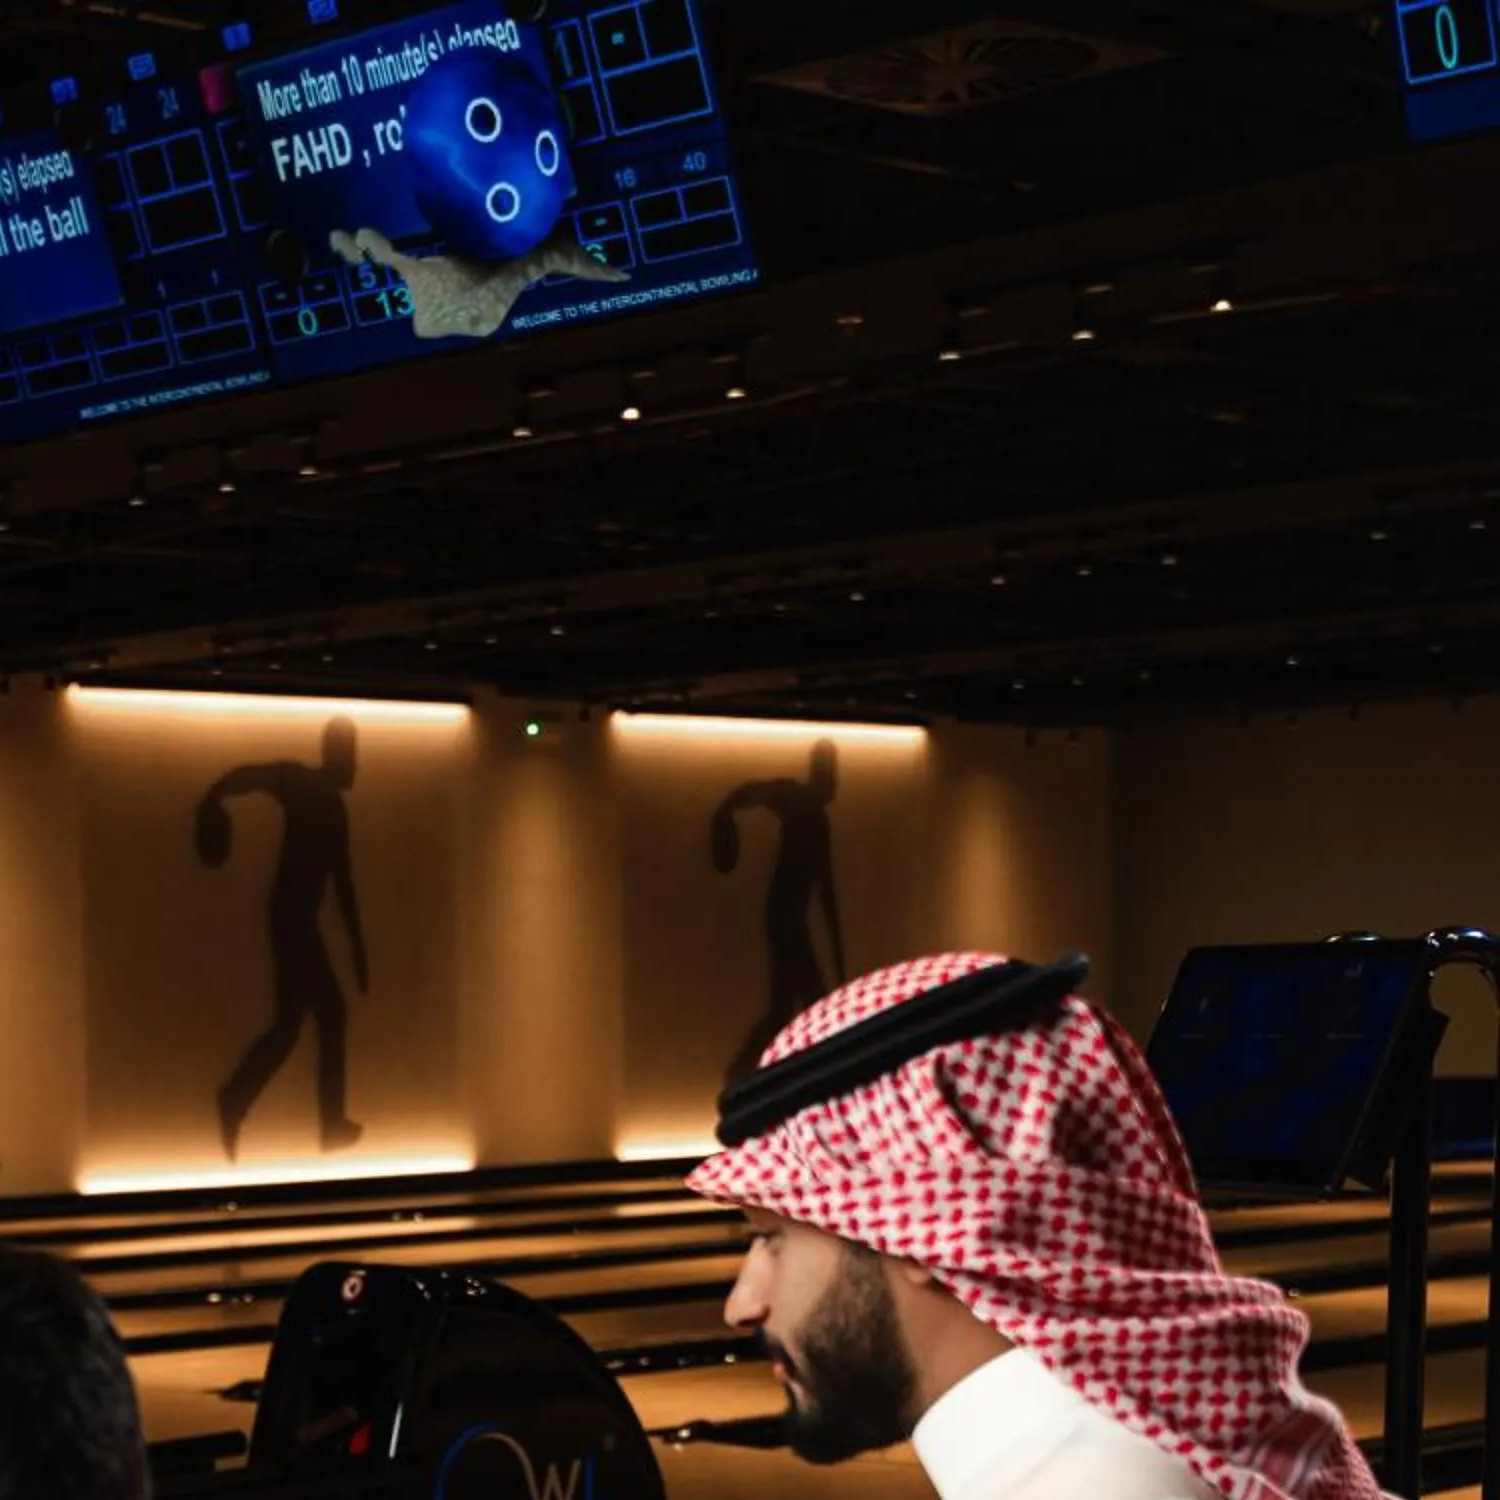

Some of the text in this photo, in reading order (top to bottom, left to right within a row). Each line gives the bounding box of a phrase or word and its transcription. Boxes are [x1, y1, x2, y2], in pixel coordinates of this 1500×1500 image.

[257, 79, 303, 122] More
[300, 67, 343, 109] than
[341, 54, 365, 98] 10
[17, 149, 76, 195] elapsed
[270, 122, 353, 183] FAHD
[373, 104, 408, 156] ro
[8, 212, 47, 253] the
[44, 194, 91, 243] ball
